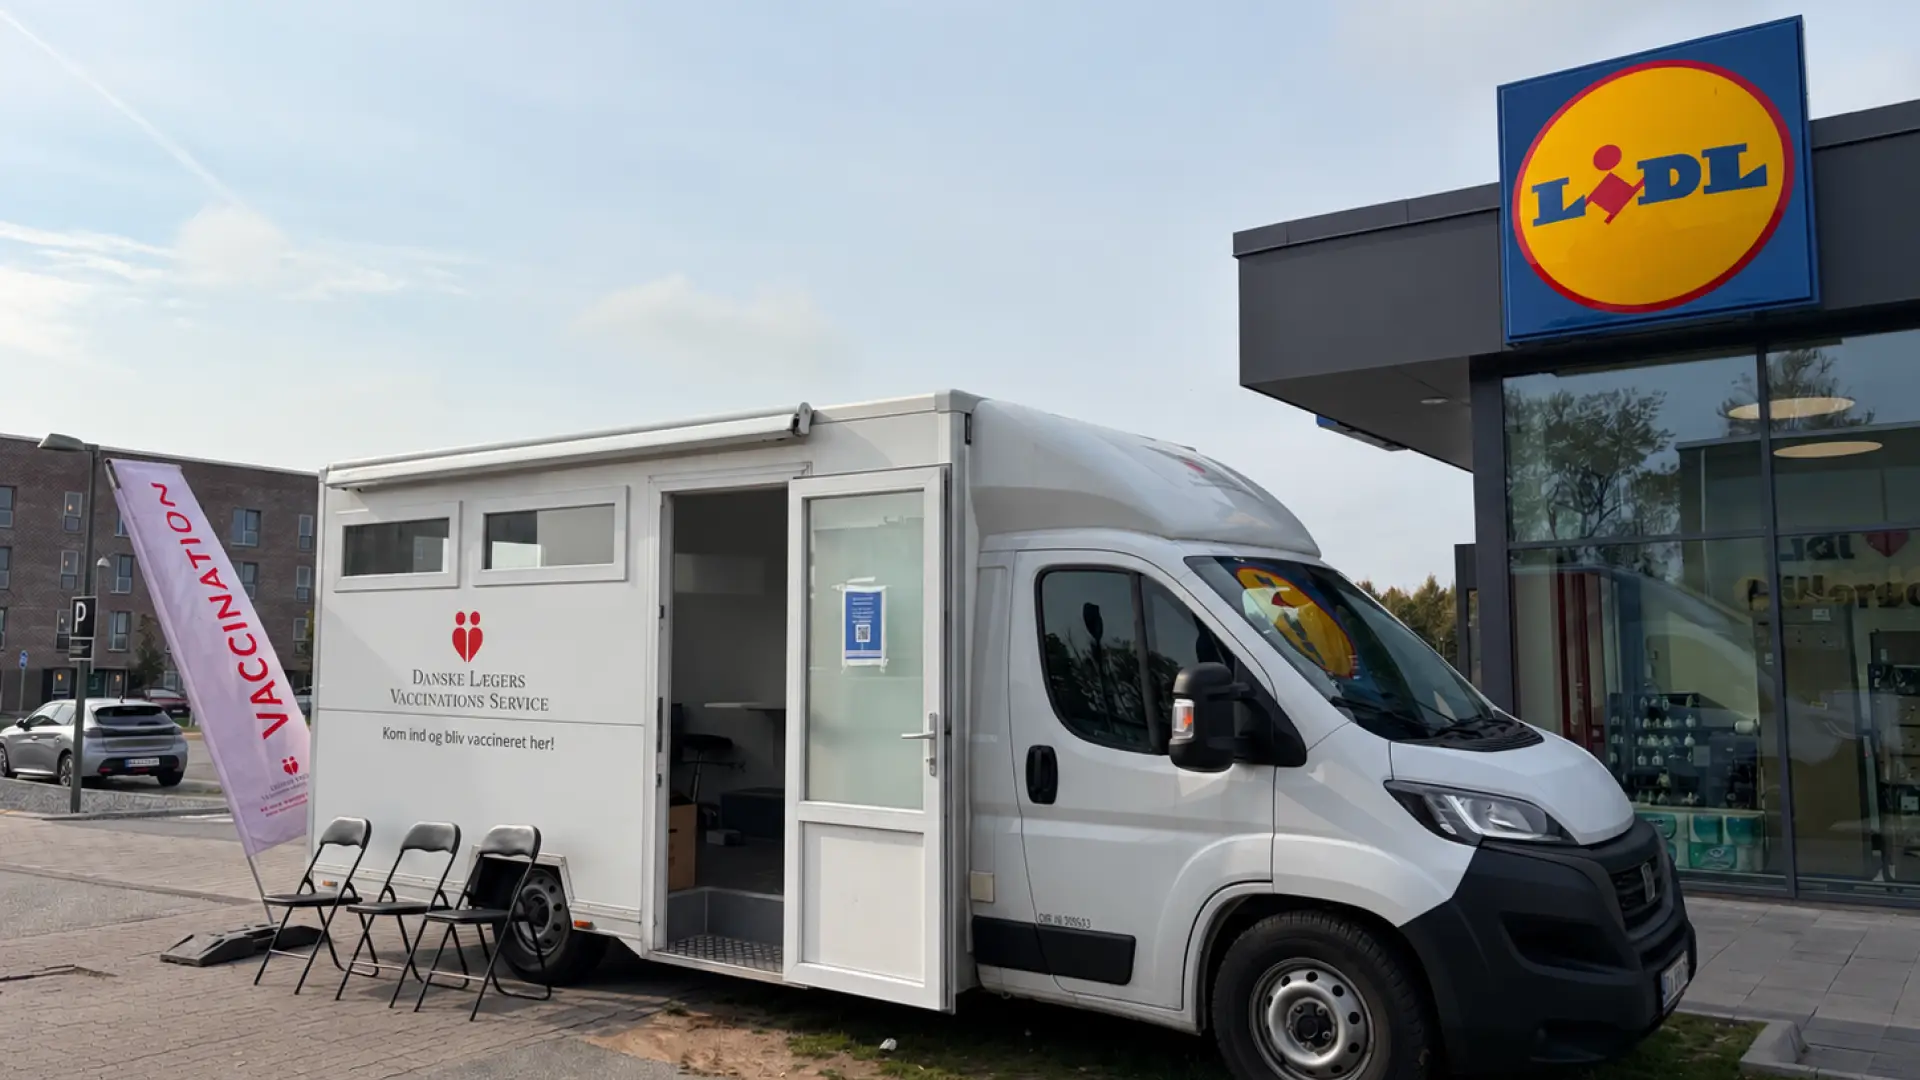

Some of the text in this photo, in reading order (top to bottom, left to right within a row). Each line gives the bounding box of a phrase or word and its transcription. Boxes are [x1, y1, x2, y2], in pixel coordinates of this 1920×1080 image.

[74, 601, 86, 633] P
[151, 482, 288, 740] VACCINATION
[412, 669, 526, 688] DANSKE LÆGERS
[390, 688, 549, 711] VACCINATIONS SERVICE
[382, 727, 555, 750] Kom ind og bliv vaccineret her!
